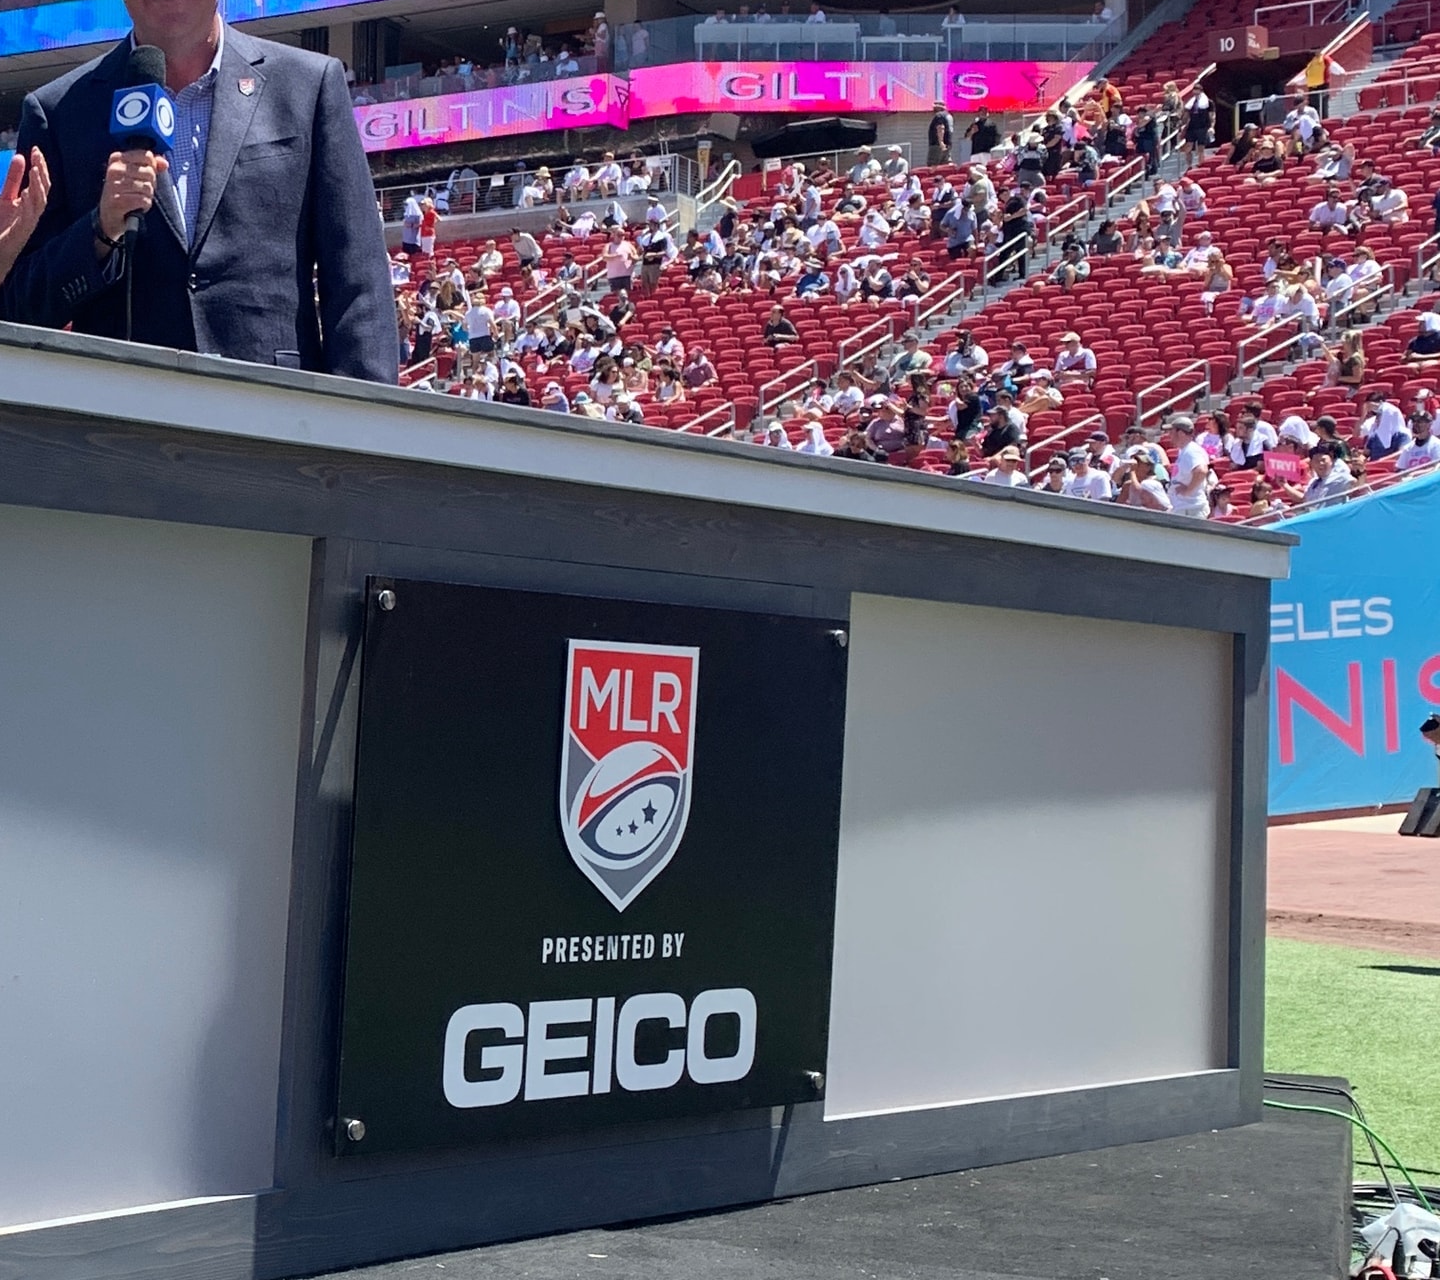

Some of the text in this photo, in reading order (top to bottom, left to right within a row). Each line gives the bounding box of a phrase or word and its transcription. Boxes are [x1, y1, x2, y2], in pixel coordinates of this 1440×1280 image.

[1219, 36, 1236, 53] 10
[718, 71, 989, 100] GILTINIS
[361, 86, 596, 142] GILTINIS
[1268, 457, 1297, 473] TRY!
[577, 665, 683, 734] MLR
[541, 932, 686, 964] PRESENTED BY
[442, 986, 758, 1109] GEICO
